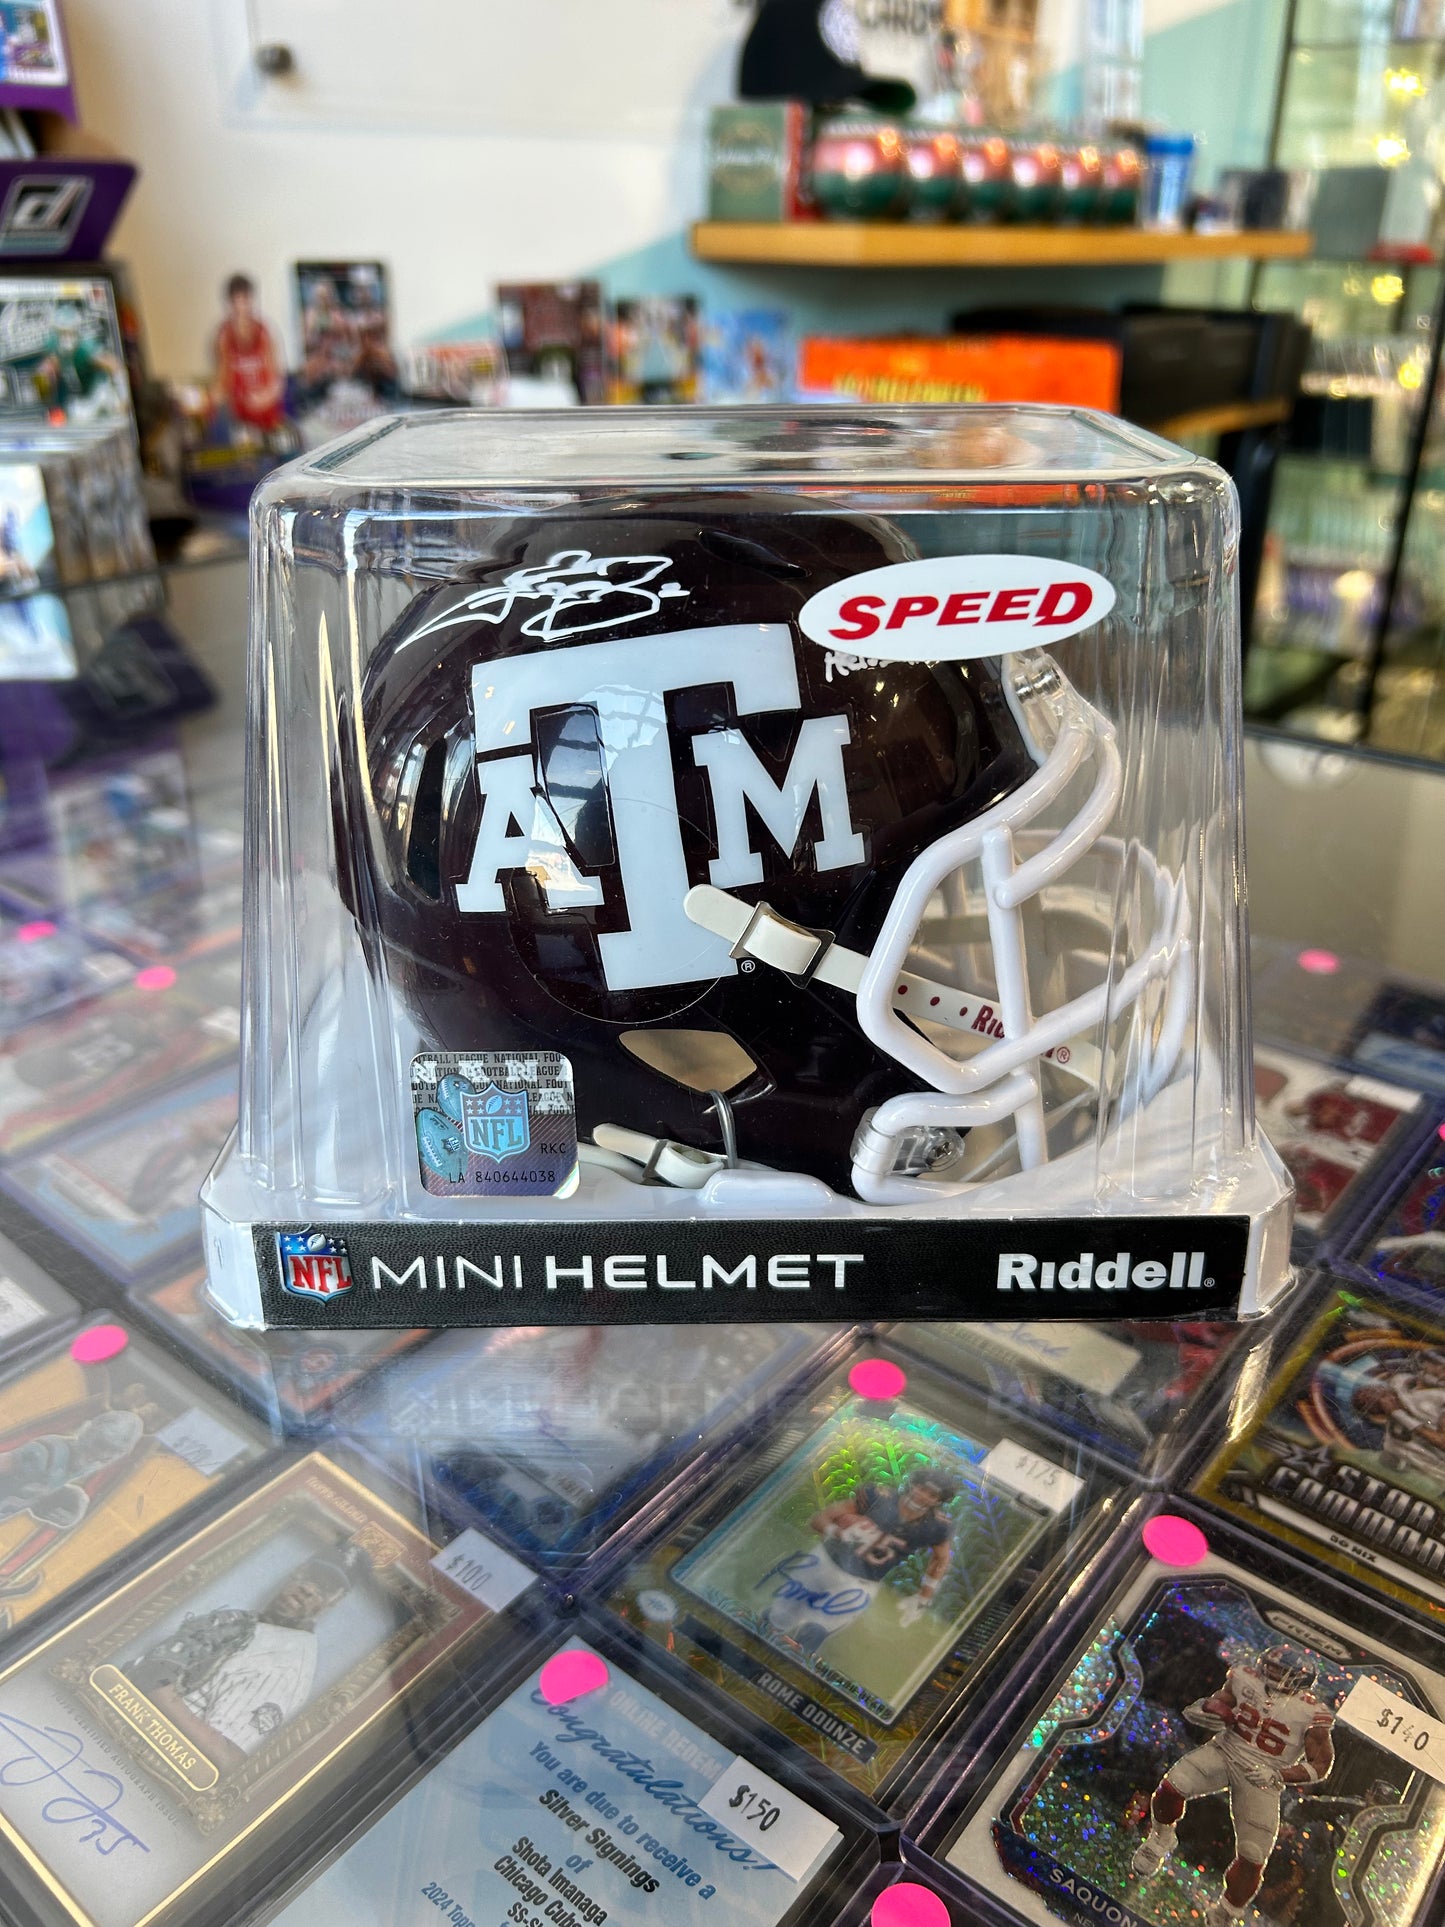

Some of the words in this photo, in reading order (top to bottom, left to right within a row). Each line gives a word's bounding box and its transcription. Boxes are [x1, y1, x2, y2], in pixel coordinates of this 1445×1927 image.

[828, 581, 1093, 640] SPEED
[470, 1118, 523, 1151] NFL
[540, 1143, 567, 1154] RKC
[450, 1172, 466, 1183] LA
[475, 1171, 556, 1182] 840644038
[289, 1255, 353, 1293] NFL
[372, 1255, 523, 1289] MINI
[545, 1254, 865, 1289] HELMET
[1266, 1466, 1445, 1572] COMMAN
[446, 1553, 493, 1591] $100
[108, 1683, 151, 1725] FRANK
[147, 1716, 198, 1770] THOMAS
[610, 1690, 669, 1739] ONLINE
[663, 1726, 725, 1781] REDEM
[757, 1671, 804, 1713] ROME
[801, 1702, 868, 1755] ODUNZE
[1231, 1702, 1291, 1756] 26
[1375, 1707, 1430, 1751] $140
[72, 1714, 113, 1755] CERTIFIED
[109, 1753, 157, 1802] AUTOGRAPH
[529, 1741, 562, 1772] You
[557, 1769, 588, 1794] are
[585, 1790, 620, 1821] due
[616, 1814, 640, 1837] to
[635, 1832, 702, 1888] receive
[698, 1883, 717, 1900] a
[728, 1784, 781, 1832] $150
[539, 1789, 590, 1832] Silver
[585, 1827, 660, 1893] Signings
[565, 1853, 594, 1875] of
[420, 1882, 454, 1911] 2024
[493, 1855, 549, 1906] Chicago
[511, 1836, 552, 1877] Shota
[547, 1867, 608, 1926] Imanaga
[1049, 1868, 1138, 1927] SAQUON
